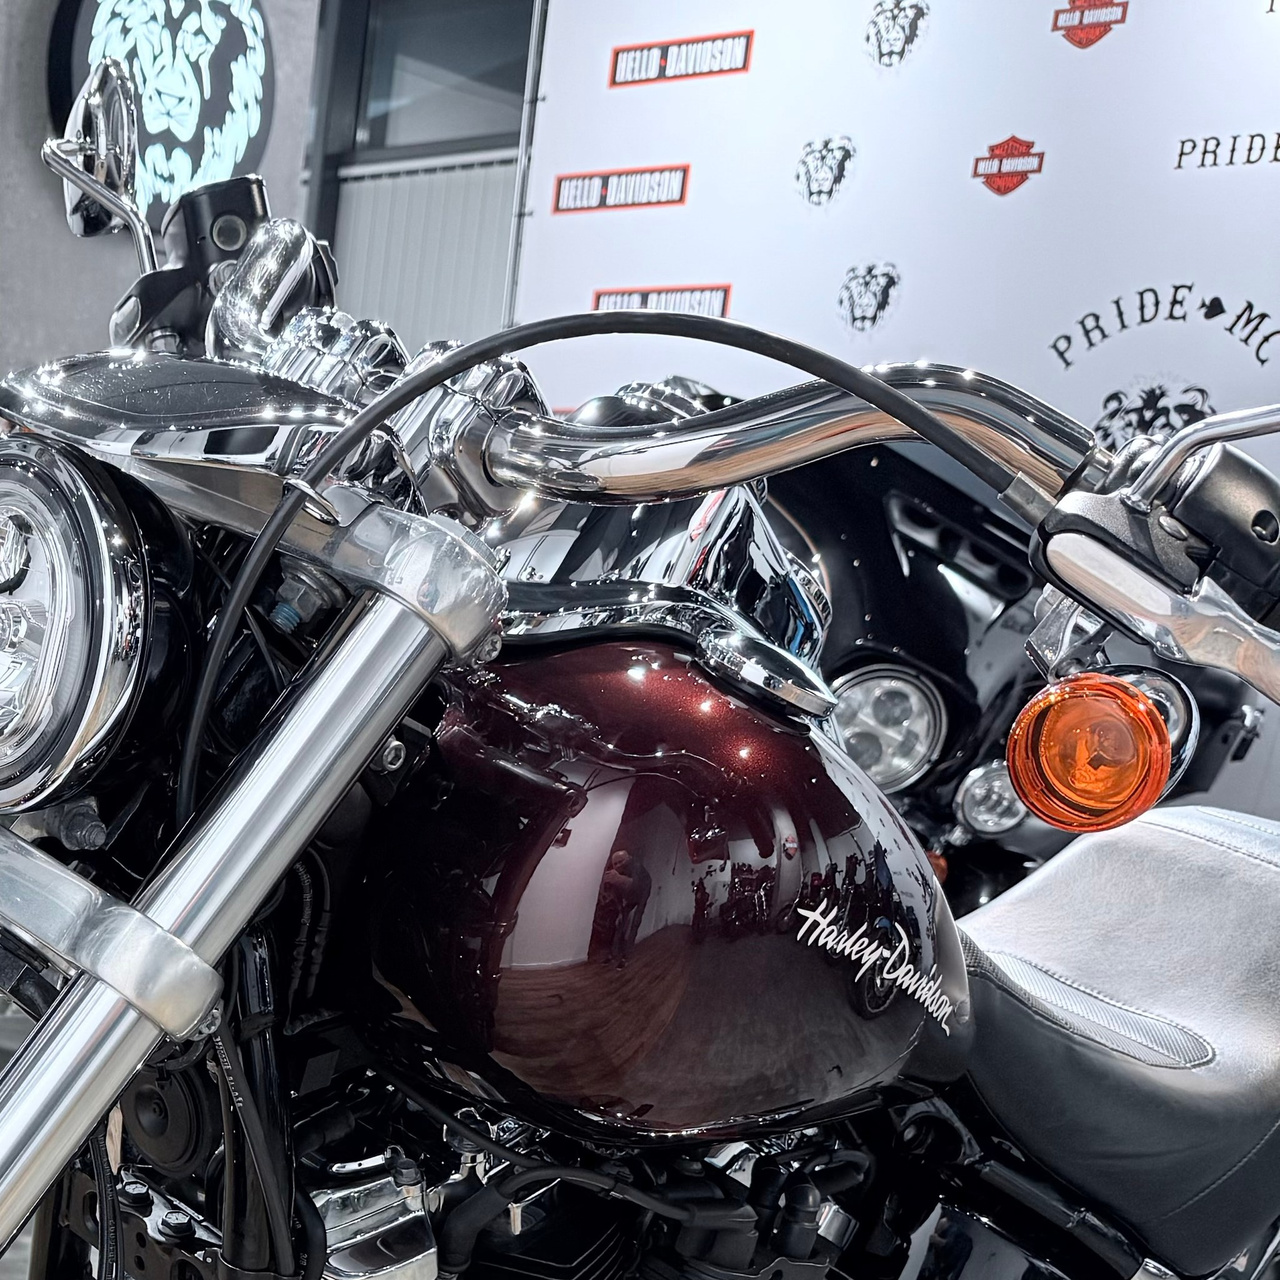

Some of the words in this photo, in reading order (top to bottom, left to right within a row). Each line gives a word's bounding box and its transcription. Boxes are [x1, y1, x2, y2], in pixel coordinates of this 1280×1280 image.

[615, 47, 662, 83] HELLO
[665, 36, 748, 77] DAVIDSON
[1173, 132, 1280, 170] PRIDE
[558, 176, 603, 210] HELLO
[605, 169, 685, 206] DAVIDSON
[1048, 281, 1194, 371] PRIDE
